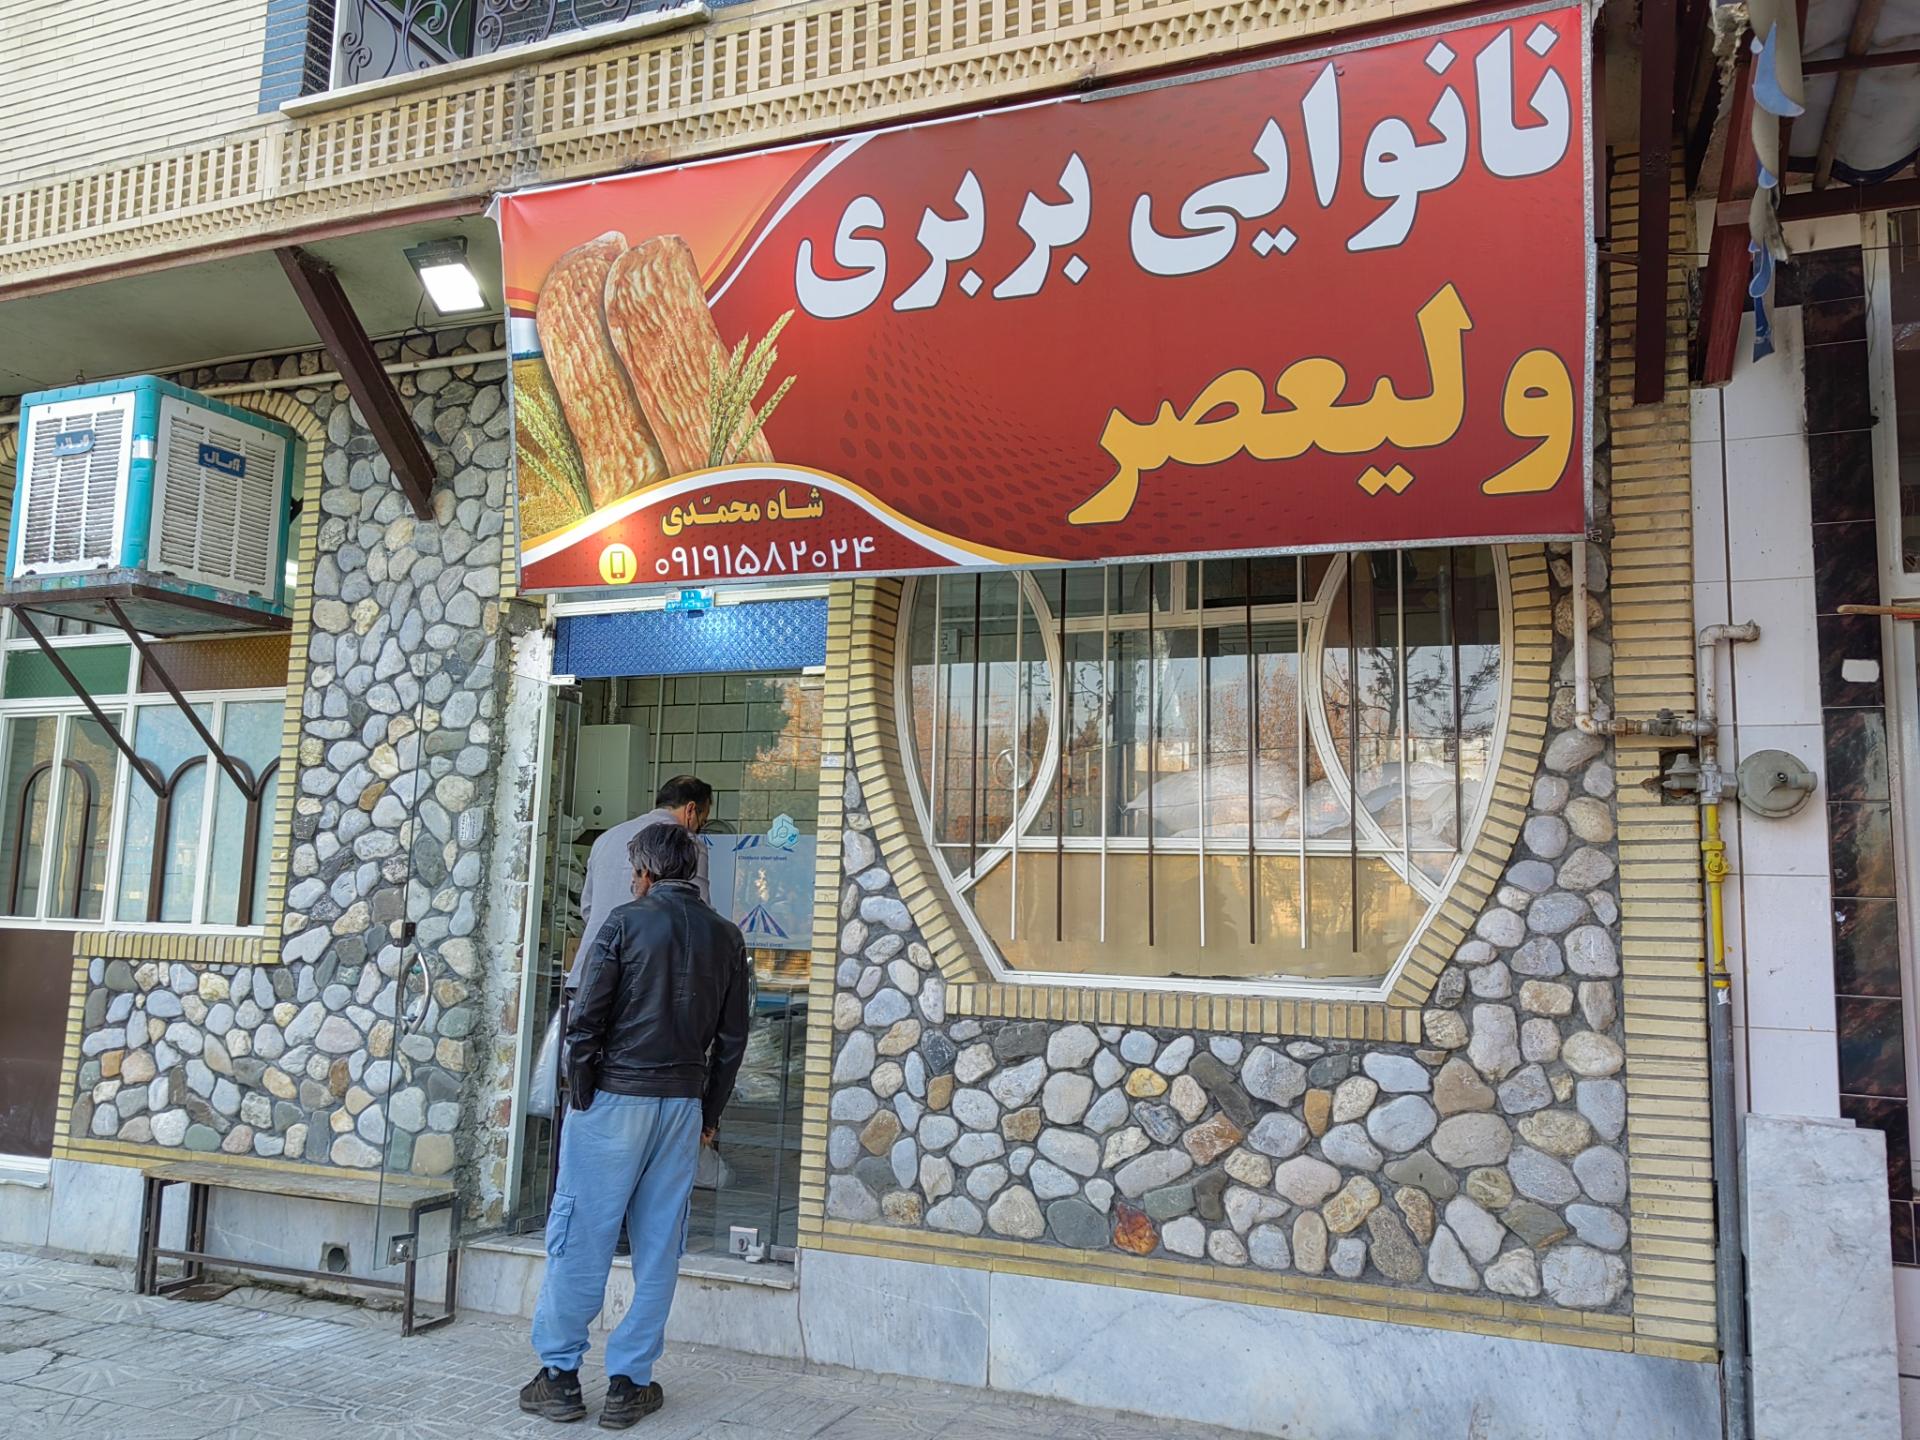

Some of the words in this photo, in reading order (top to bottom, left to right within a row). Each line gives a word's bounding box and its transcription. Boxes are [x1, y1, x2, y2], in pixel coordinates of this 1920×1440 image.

[1130, 23, 1570, 275] نانوایی
[795, 153, 1091, 319] بربری
[1068, 284, 1574, 525] ولیعصر
[655, 537, 876, 577] ۰۹۱۹۱۵۸۲۰۲۴
[766, 486, 824, 521] شاه
